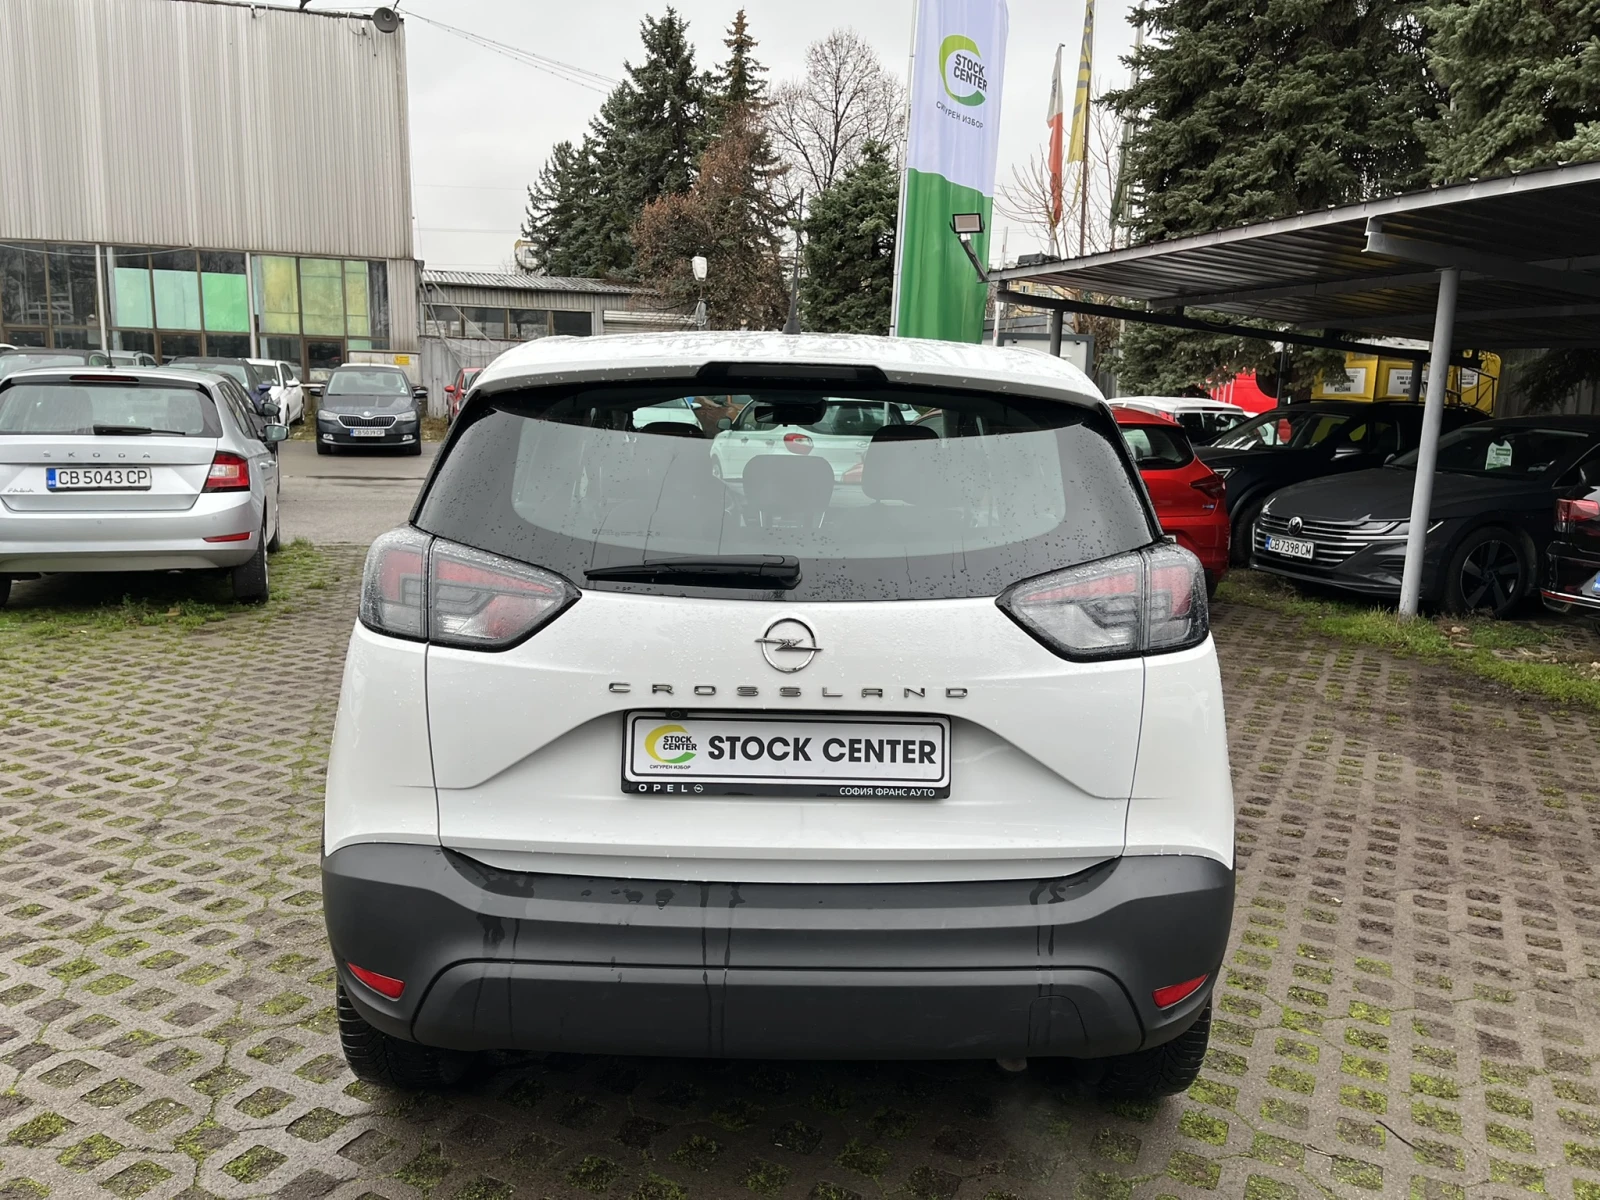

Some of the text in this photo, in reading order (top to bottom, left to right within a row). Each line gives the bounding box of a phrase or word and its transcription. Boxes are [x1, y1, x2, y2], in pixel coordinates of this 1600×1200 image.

[954, 53, 985, 78] STOCK
[953, 66, 988, 92] CENTER
[962, 115, 984, 129] ИЗБОР
[58, 470, 80, 485] CB
[83, 470, 123, 485] 5043
[126, 470, 148, 484] CP
[1270, 538, 1312, 557] CB 7398 CM
[608, 682, 969, 699] CROSSLAND
[662, 742, 697, 751] CENTER
[663, 735, 692, 743] STOCK
[708, 735, 937, 765] STOCK CENTER
[638, 783, 688, 793] OPEL
[839, 787, 936, 797] СОФИЯ ФРАНС АУТО
